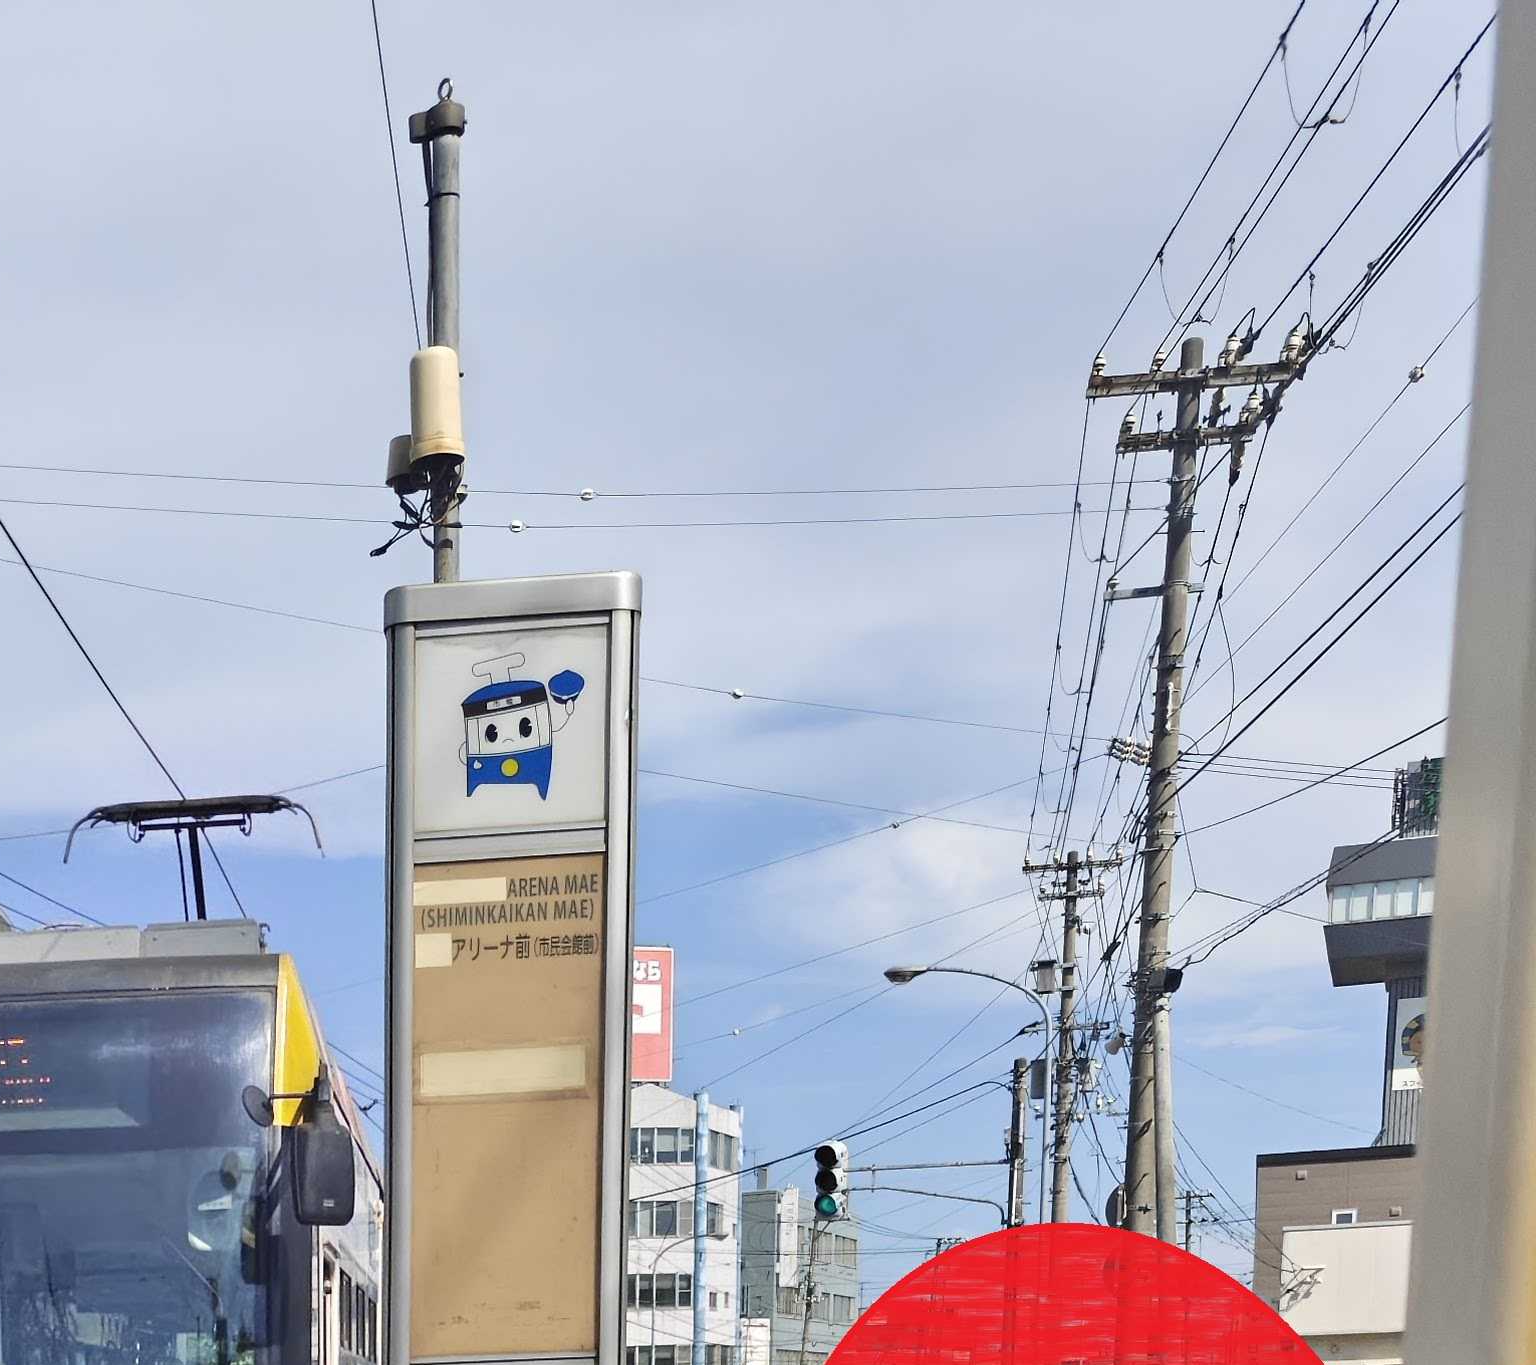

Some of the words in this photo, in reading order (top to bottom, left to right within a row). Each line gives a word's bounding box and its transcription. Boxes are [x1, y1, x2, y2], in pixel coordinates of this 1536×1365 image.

[507, 876, 560, 898] ARENA
[564, 873, 599, 894] MAE
[421, 901, 548, 930] (SHIMINKAIKAN
[553, 899, 594, 920] MAE)
